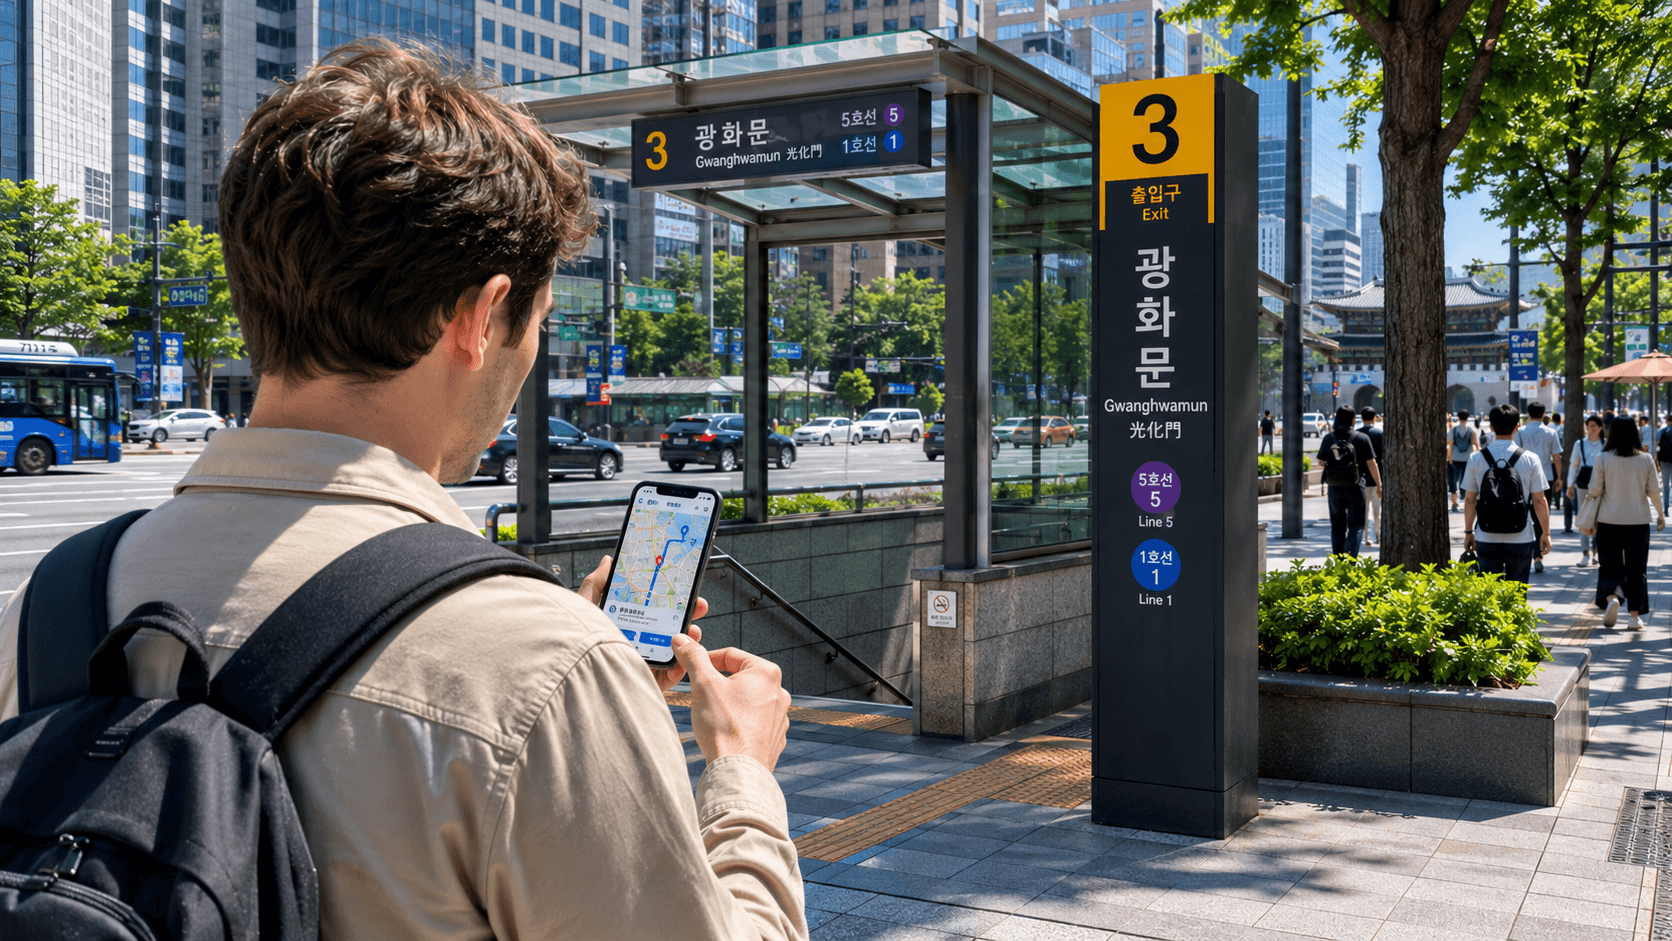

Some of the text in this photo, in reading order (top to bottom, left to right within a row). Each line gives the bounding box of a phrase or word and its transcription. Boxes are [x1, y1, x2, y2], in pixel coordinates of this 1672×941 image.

[842, 107, 899, 127] 5호선 5
[695, 119, 770, 151] 광화문
[1132, 93, 1180, 165] 3
[645, 131, 668, 171] 3
[842, 134, 897, 154] 1호선 1
[695, 144, 822, 169] Gwanghwamun 光化門
[1130, 184, 1182, 205] 출입구
[1142, 208, 1170, 221] Exit
[1135, 246, 1176, 389] 광화문
[1104, 398, 1208, 416] Gwanghwamun
[1129, 421, 1182, 439] 光化門
[1139, 472, 1173, 488] 5호선
[1150, 491, 1161, 508] 5
[1138, 516, 1174, 528] Line 5
[1139, 551, 1173, 566] 1호선
[1151, 569, 1159, 585] 1
[1139, 594, 1172, 606] Line 1
